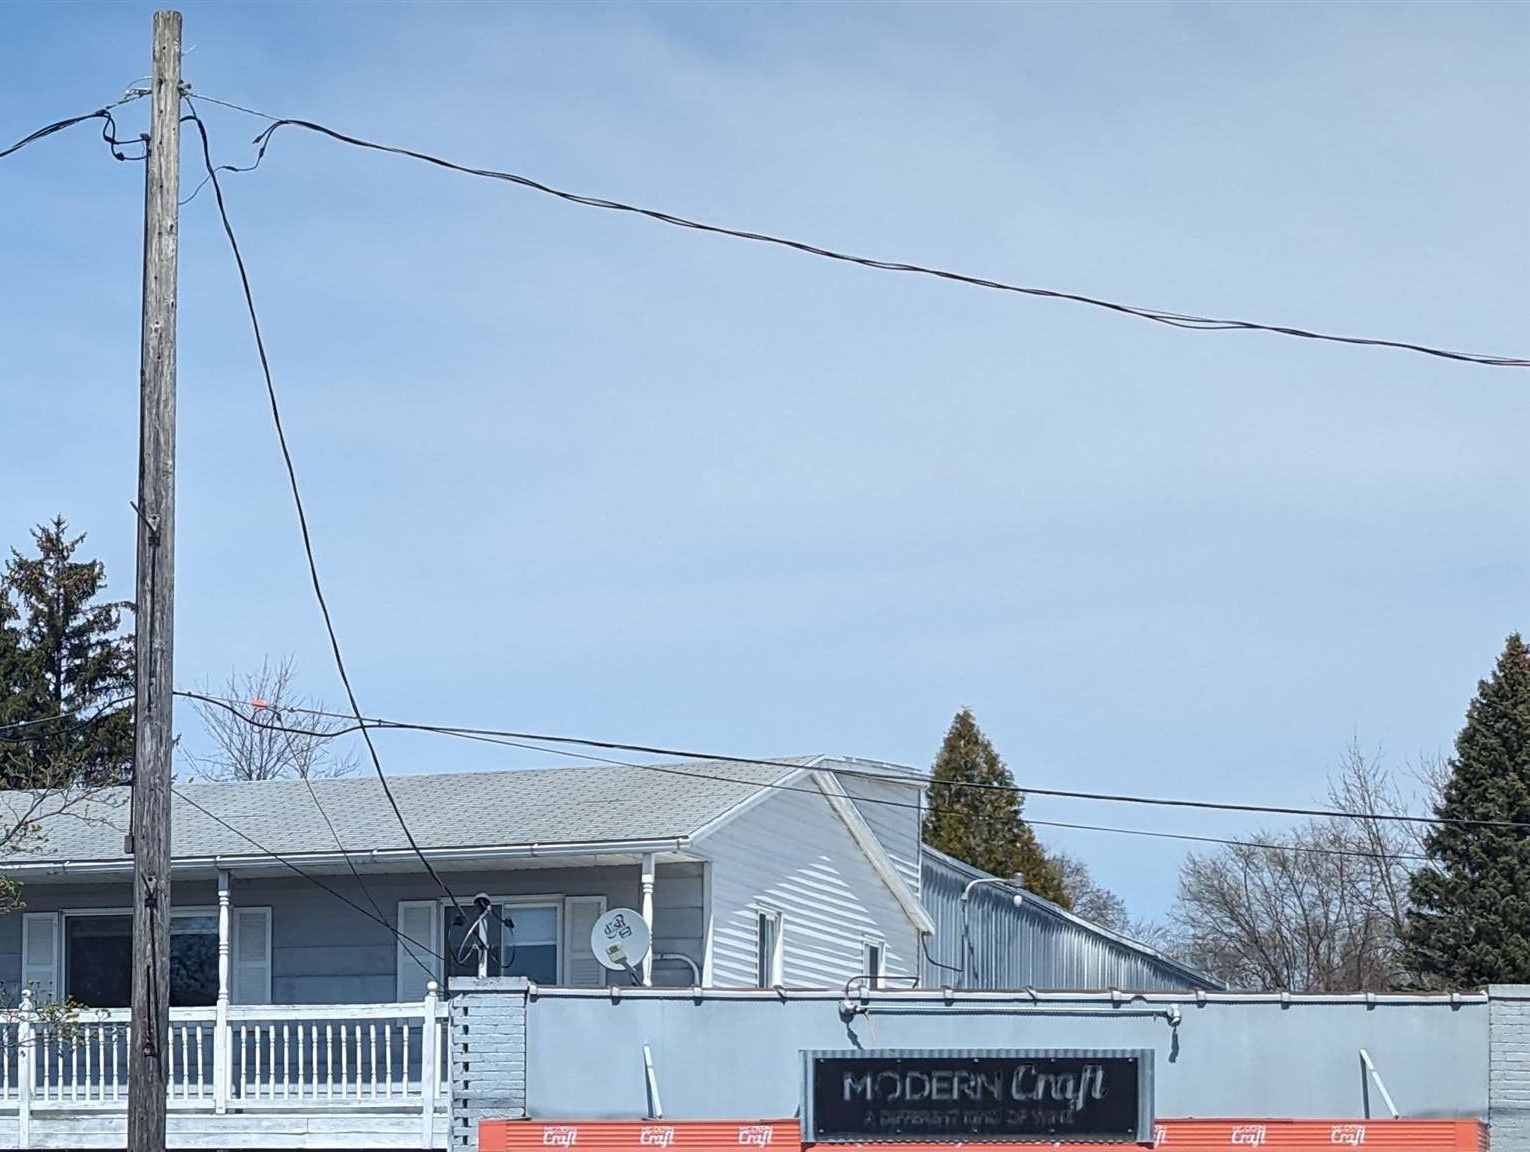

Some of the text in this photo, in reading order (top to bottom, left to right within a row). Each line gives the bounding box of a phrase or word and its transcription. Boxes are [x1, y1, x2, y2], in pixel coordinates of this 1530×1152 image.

[842, 1063, 1109, 1111] MODERN Craft
[542, 1128, 577, 1147] Craft
[640, 1128, 674, 1147] Craft
[739, 1126, 773, 1147] Craft
[1231, 1127, 1266, 1147] Craft
[1330, 1127, 1366, 1146] Craft
